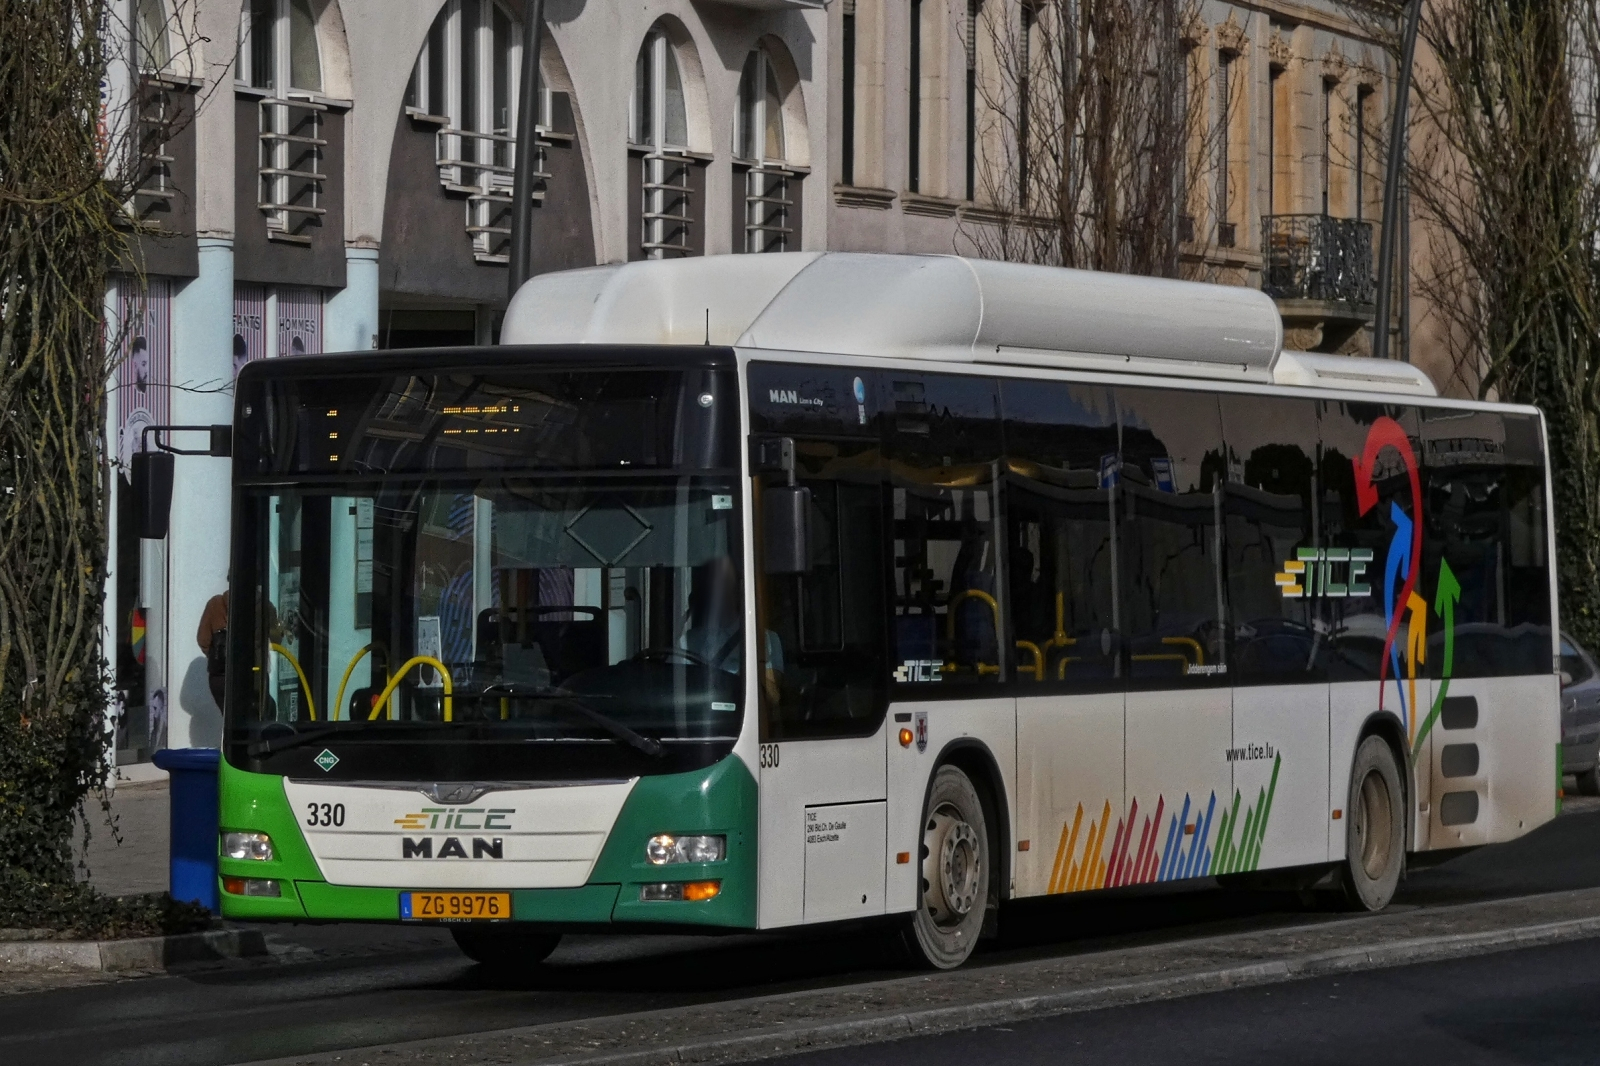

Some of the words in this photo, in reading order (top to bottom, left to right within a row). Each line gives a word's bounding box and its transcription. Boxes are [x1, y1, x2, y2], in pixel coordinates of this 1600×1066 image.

[279, 319, 316, 334] HOMMES
[769, 389, 798, 404] MAN
[813, 397, 824, 407] City
[1296, 547, 1374, 597] TICE
[903, 660, 944, 682] TICE
[318, 756, 335, 765] CNG
[760, 743, 780, 769] 330
[1225, 742, 1275, 762] www.tice.lu
[306, 802, 346, 828] 330
[420, 807, 517, 830] TICE
[807, 812, 817, 822] TICE
[402, 836, 504, 859] MAN
[404, 906, 410, 914] L
[421, 896, 445, 915] ZG
[450, 896, 499, 915] 9976
